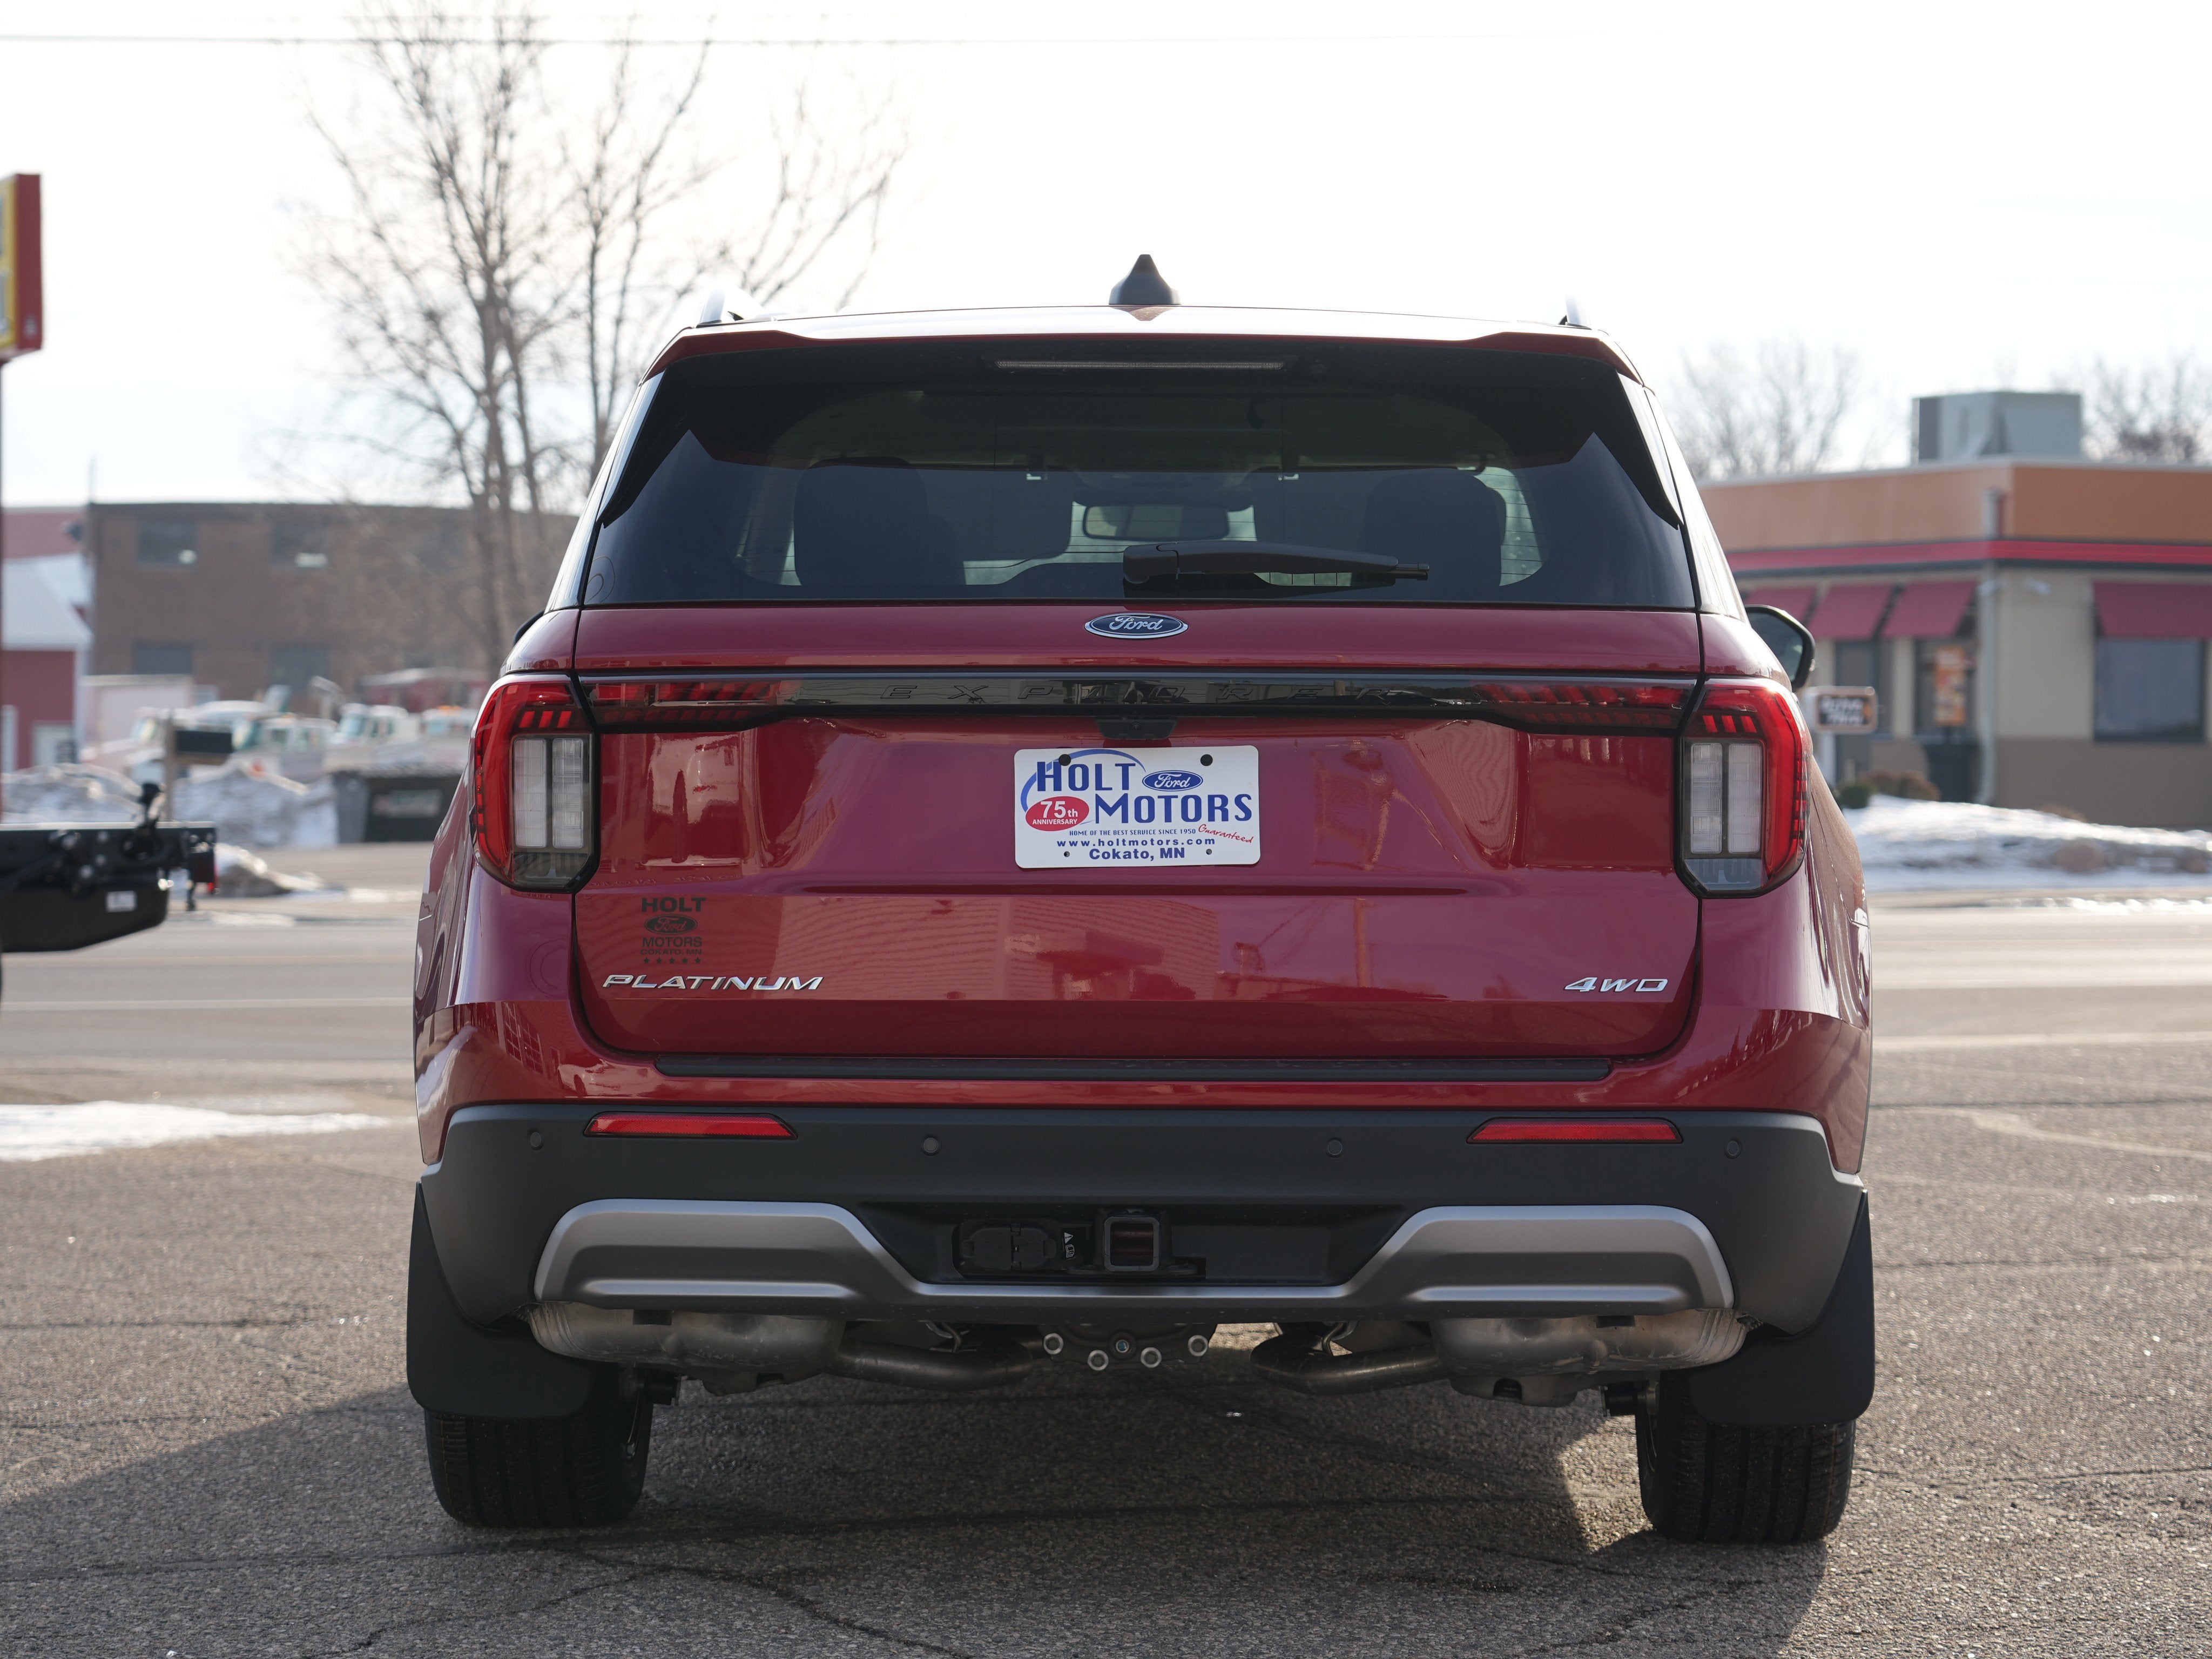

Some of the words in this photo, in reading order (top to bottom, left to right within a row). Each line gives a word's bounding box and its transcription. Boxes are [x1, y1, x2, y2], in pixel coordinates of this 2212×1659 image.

[1109, 615, 1163, 630] Ford
[1037, 761, 1136, 792] HOLT
[1154, 772, 1191, 788] Ford
[1040, 800, 1078, 818] 75th
[1095, 793, 1252, 824] MOTORS
[1198, 824, 1254, 844] Guaranteed
[1056, 838, 1215, 847] www.holtmotors.com
[1089, 848, 1154, 861] Cokato,
[1159, 847, 1185, 859] MN
[641, 897, 706, 913] HOLT
[654, 917, 687, 931] Ford
[642, 936, 702, 947] MOTORS
[602, 974, 825, 990] PLATINUM
[1564, 977, 1668, 992] 4WD
